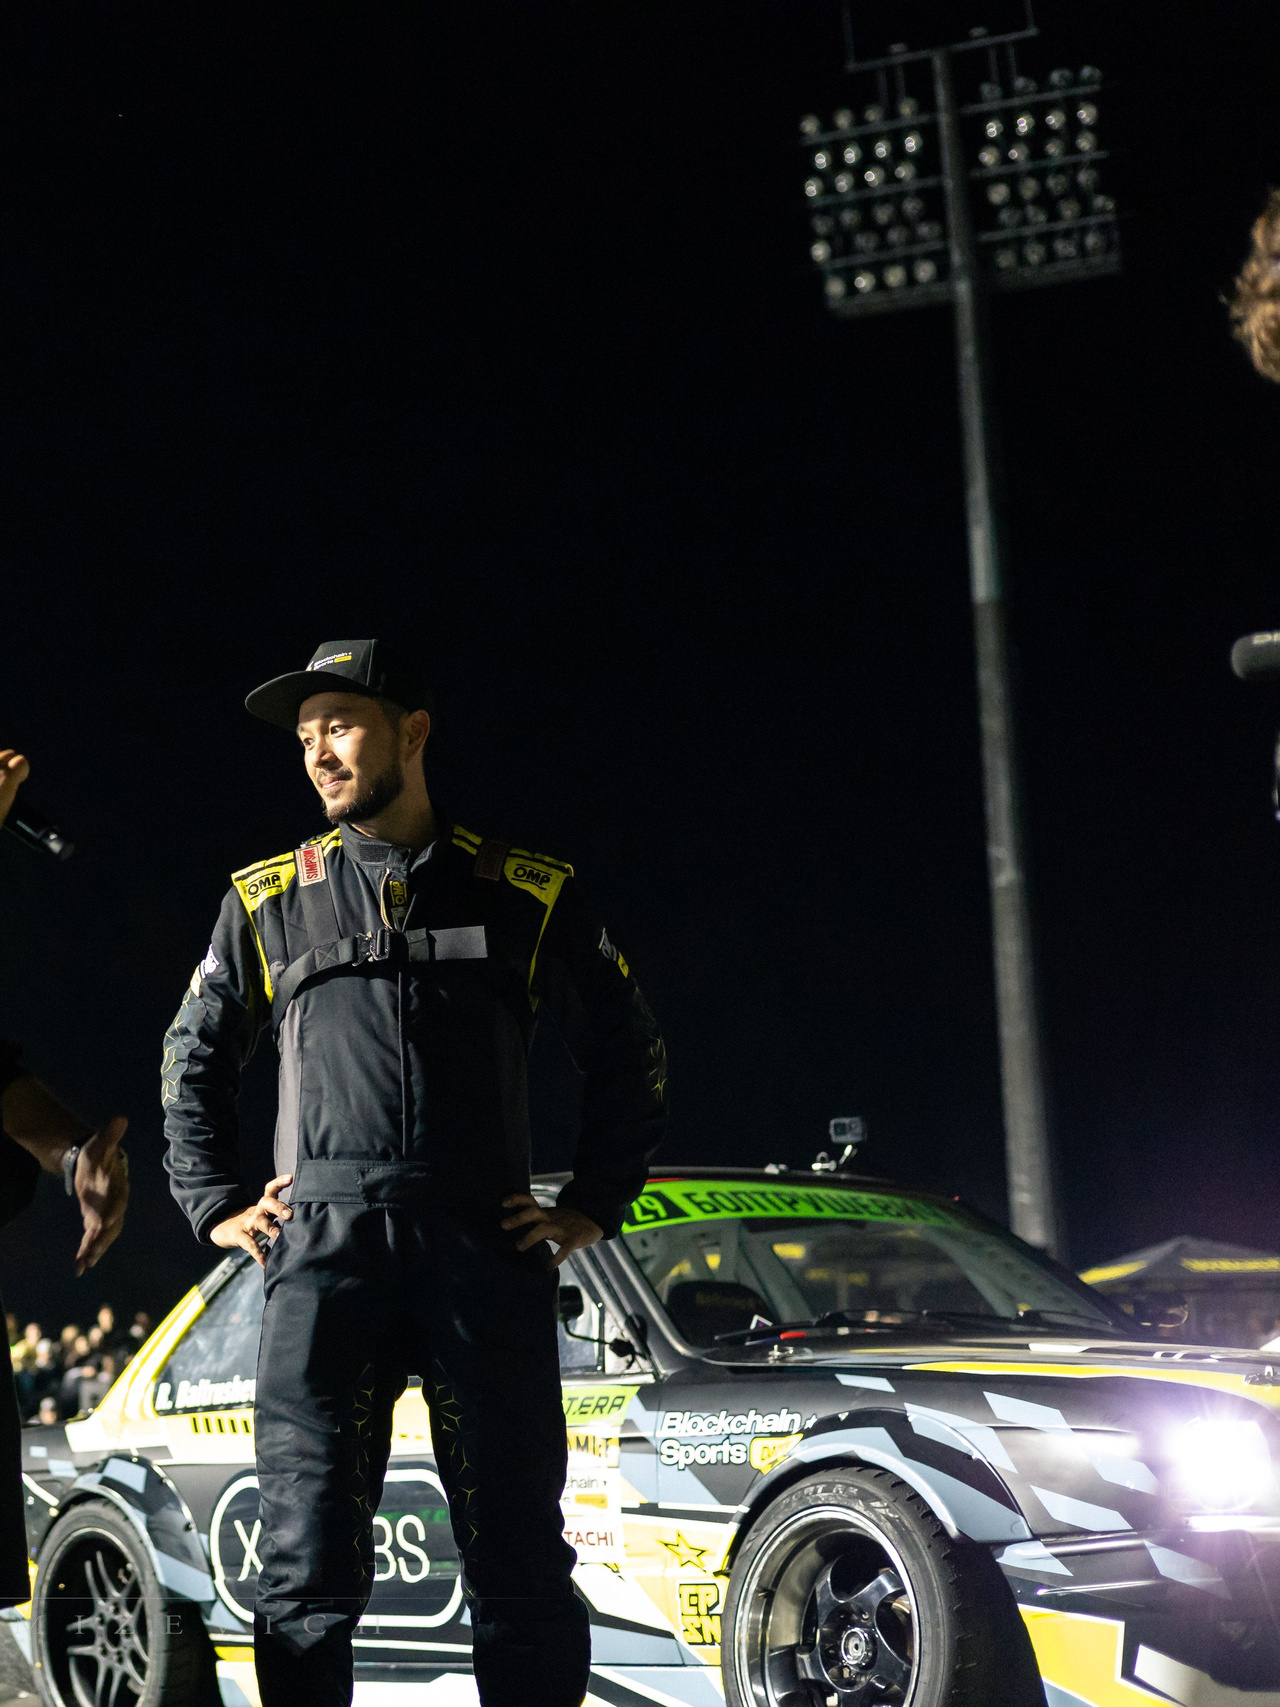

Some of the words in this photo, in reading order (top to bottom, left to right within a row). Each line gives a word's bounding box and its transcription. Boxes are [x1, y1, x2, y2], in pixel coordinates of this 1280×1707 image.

[248, 874, 280, 895] OMP
[513, 866, 551, 886] OMP
[565, 1396, 626, 1415] T.ERA
[658, 1408, 802, 1437] Blockchain
[660, 1437, 747, 1471] Sports
[564, 1531, 614, 1546] TACHI
